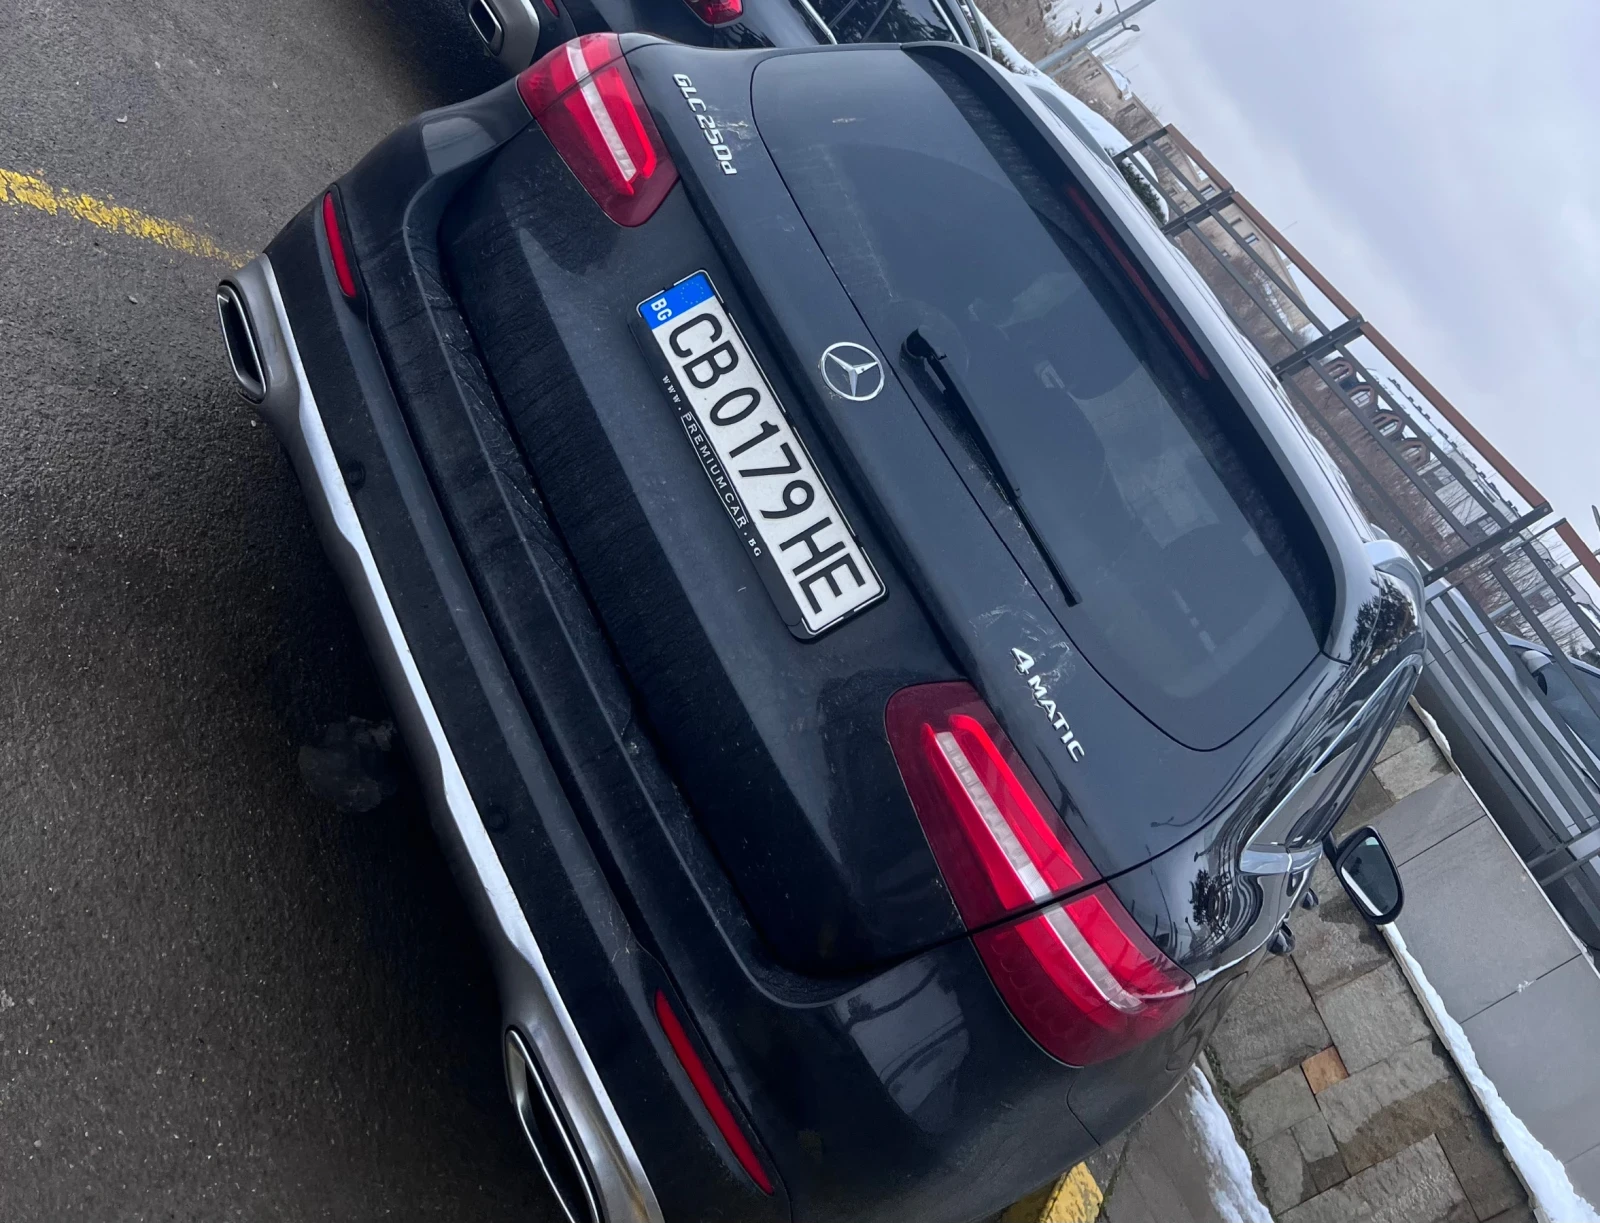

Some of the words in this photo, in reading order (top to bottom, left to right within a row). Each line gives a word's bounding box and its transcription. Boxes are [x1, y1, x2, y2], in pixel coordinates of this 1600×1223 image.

[673, 73, 707, 112] GLC
[696, 114, 738, 175] 250d
[650, 297, 672, 322] BG
[669, 313, 739, 389] CB
[709, 386, 815, 520] 0179
[778, 516, 867, 616] HE
[1010, 647, 1085, 763] 4MATIC
